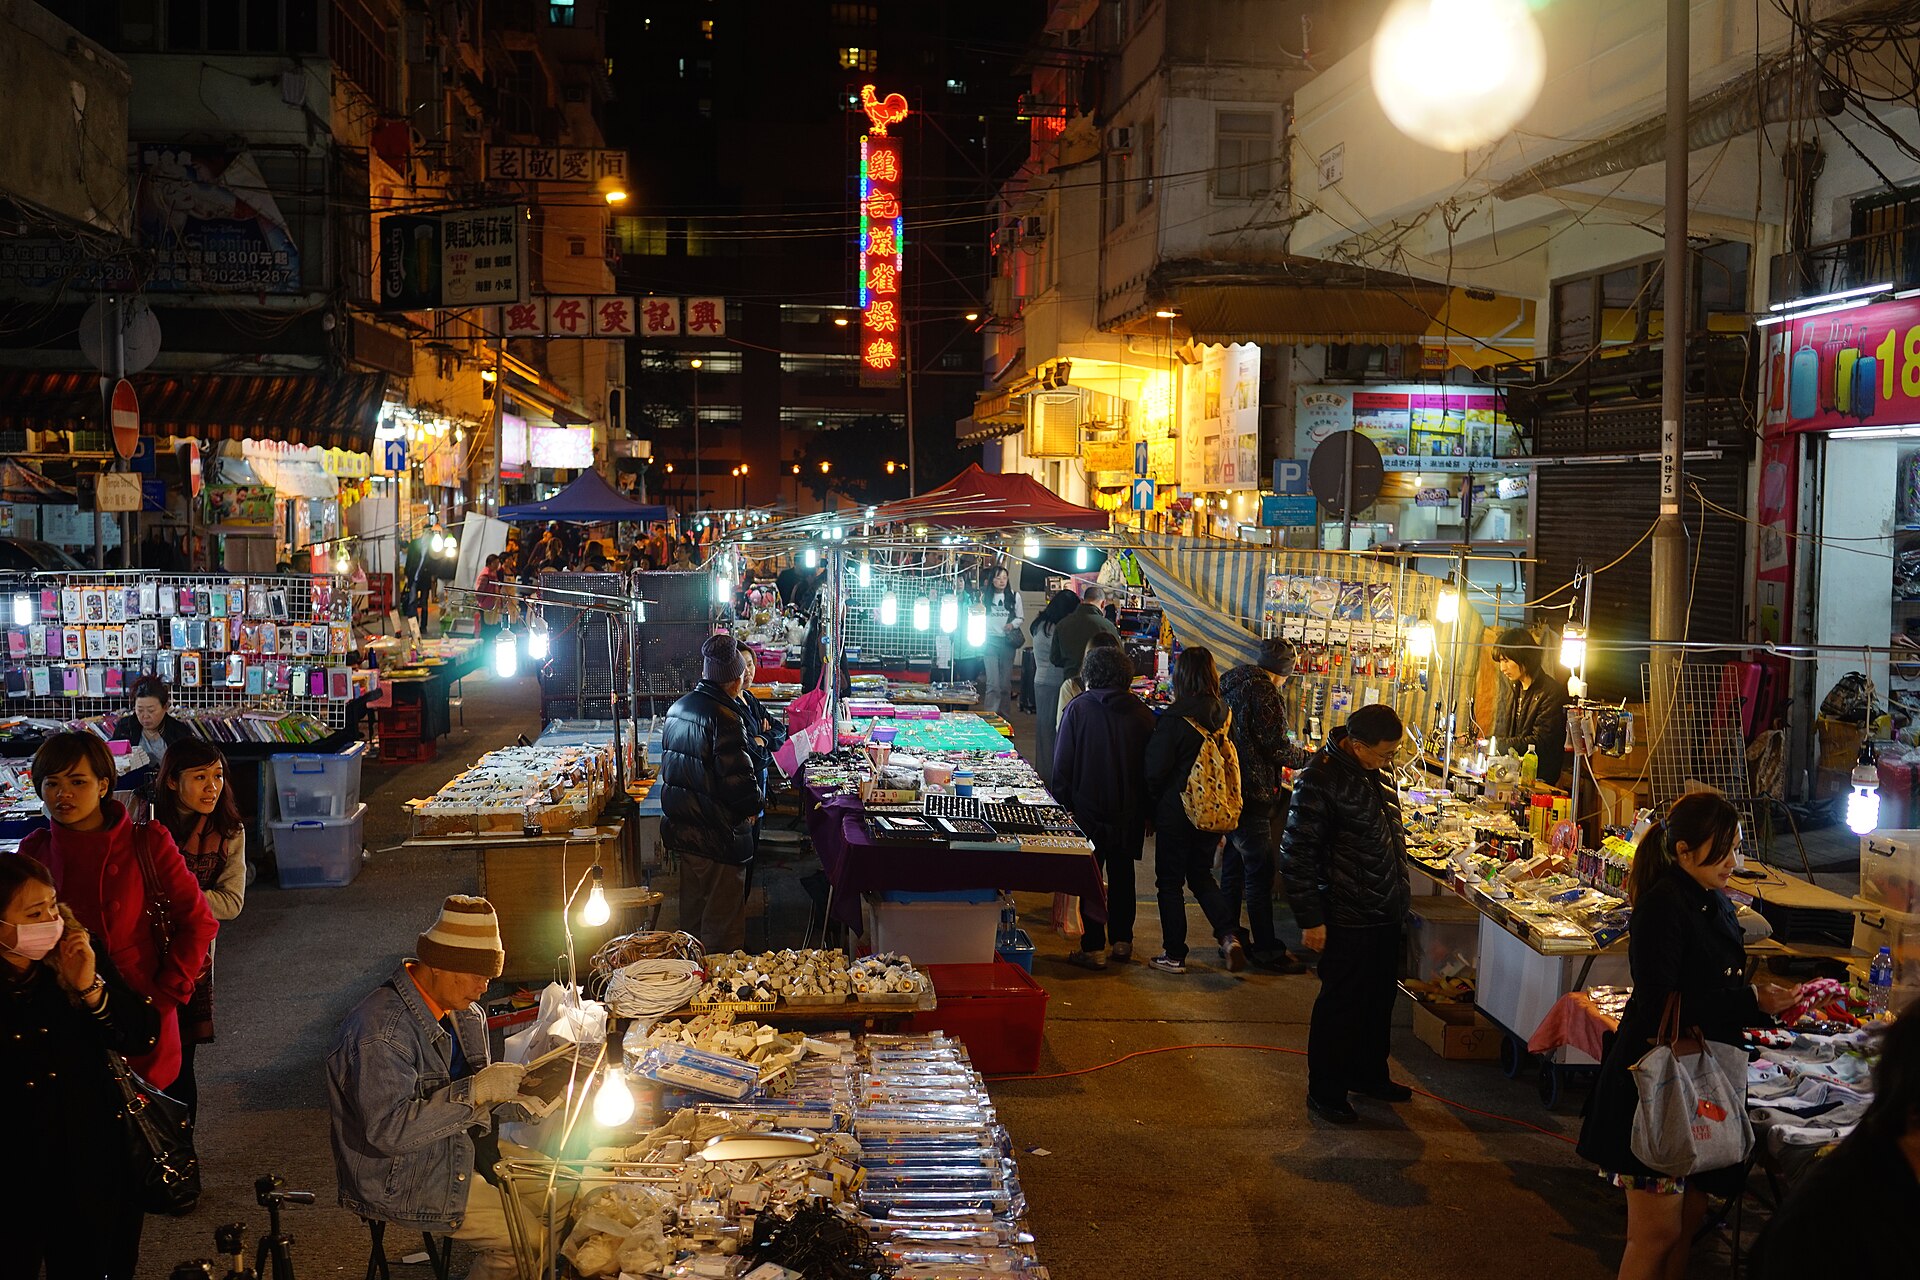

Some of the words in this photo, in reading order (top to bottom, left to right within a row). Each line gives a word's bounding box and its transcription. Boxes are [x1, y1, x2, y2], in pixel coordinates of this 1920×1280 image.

[445, 215, 513, 250] 興記煲仔飯
[386, 227, 408, 299] Carlsberg
[475, 280, 492, 292] 海鮮
[494, 279, 512, 291] 小菜
[1664, 432, 1673, 442] K
[1279, 463, 1302, 492] P
